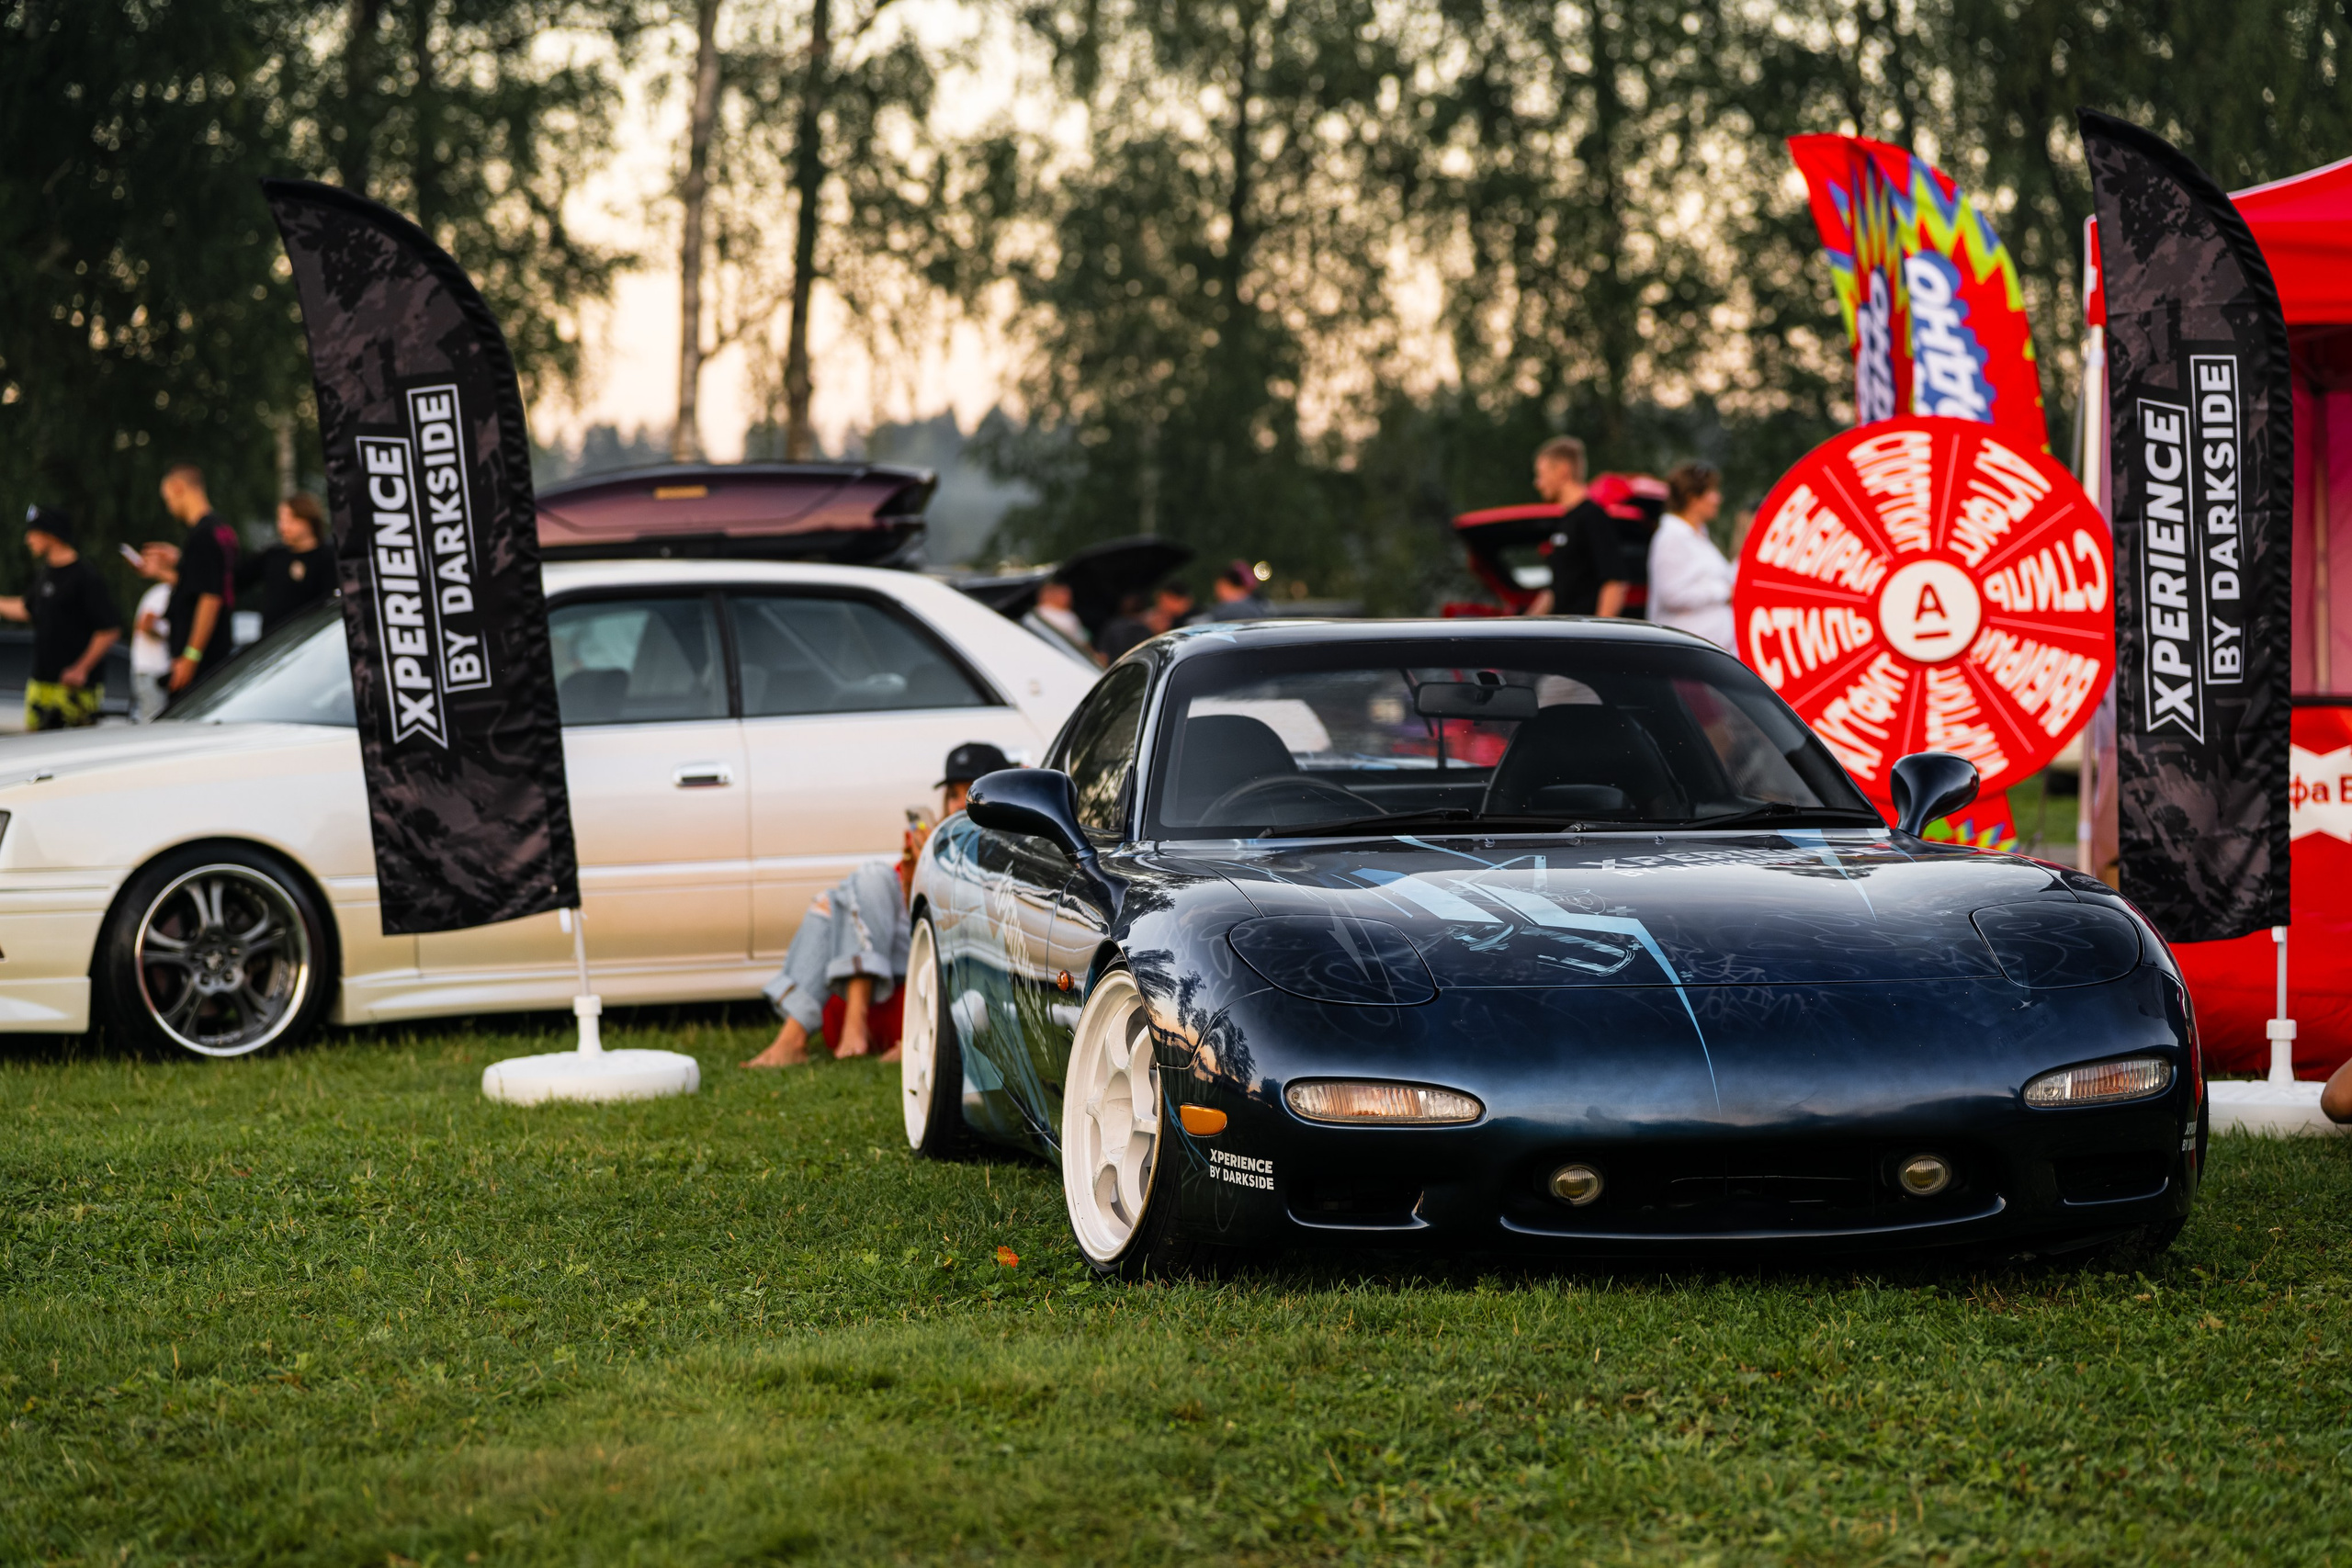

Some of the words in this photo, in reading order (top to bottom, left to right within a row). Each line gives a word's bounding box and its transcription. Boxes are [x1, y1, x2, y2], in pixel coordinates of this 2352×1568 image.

[417, 394, 473, 615] DARKSIDE
[1947, 437, 2052, 569] АУТФИТ
[2199, 364, 2241, 601] DARKSIDE
[366, 446, 436, 728] XPERIENCE
[1756, 483, 1888, 596] ВЫБИРАЙ
[1983, 528, 2109, 614] СТИЛЬ
[2144, 409, 2195, 722] XPERIENCE
[447, 631, 481, 682] BY
[1748, 605, 1874, 690] СТИЛЬ
[1968, 626, 2101, 739] ВЫБИРАЙ
[2212, 616, 2242, 674] BY
[1209, 1148, 1273, 1174] XPERIENCE
[1209, 1165, 1221, 1179] BY
[1223, 1168, 1275, 1190] DARKSIDE
